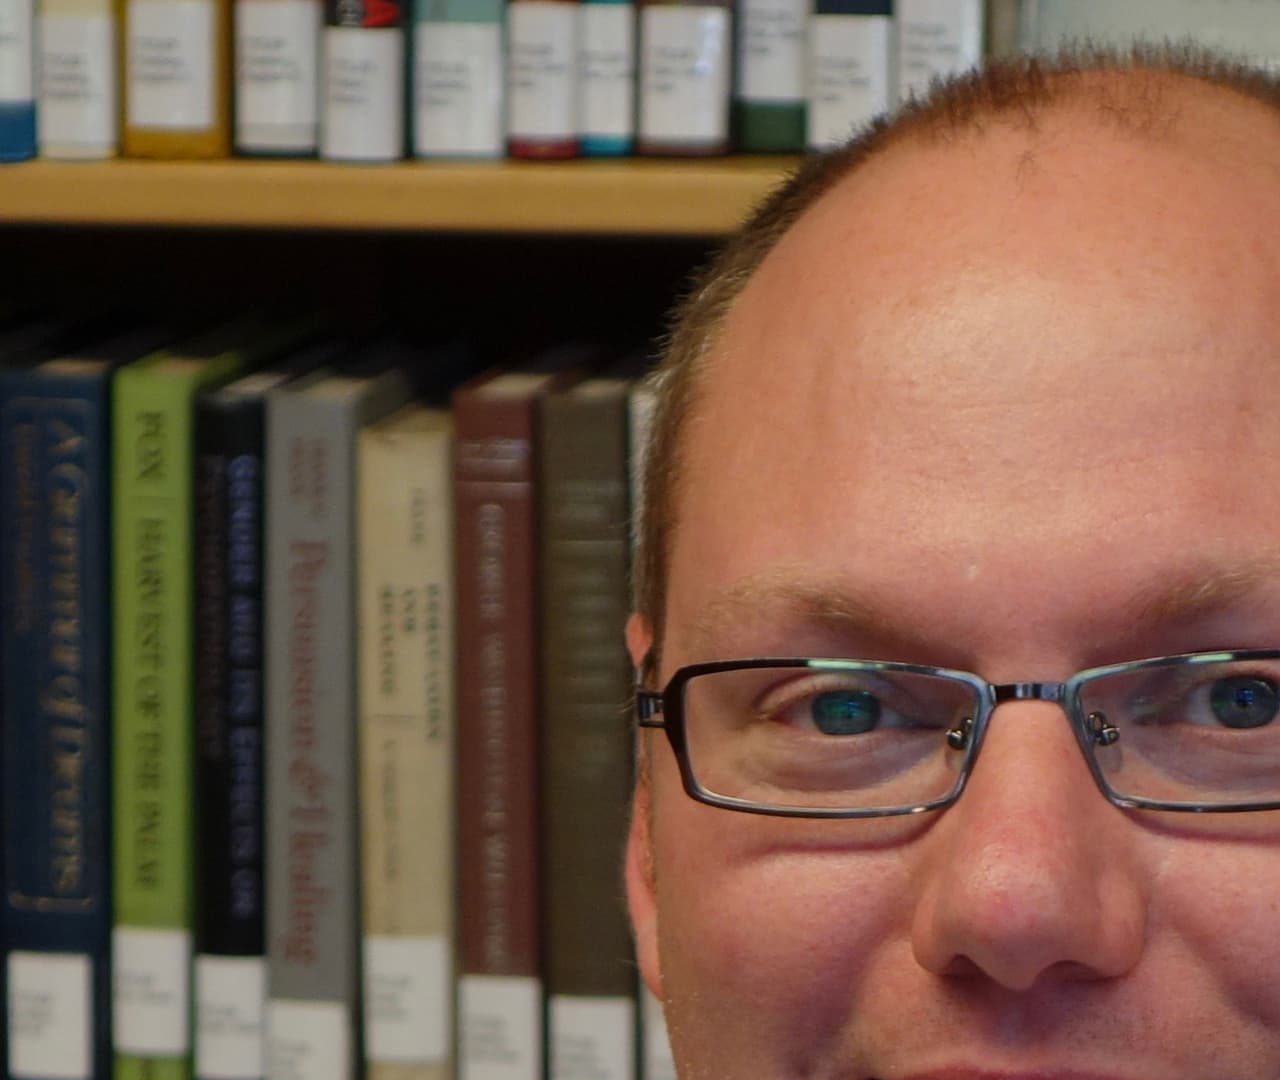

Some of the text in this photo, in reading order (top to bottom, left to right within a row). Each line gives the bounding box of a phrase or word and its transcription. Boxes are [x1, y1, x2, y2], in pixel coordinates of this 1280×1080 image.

[135, 410, 166, 482] FOX
[133, 515, 168, 673] HARVEST
[285, 540, 334, 751] Persuasion
[133, 673, 167, 720] OF
[132, 729, 165, 792] THE
